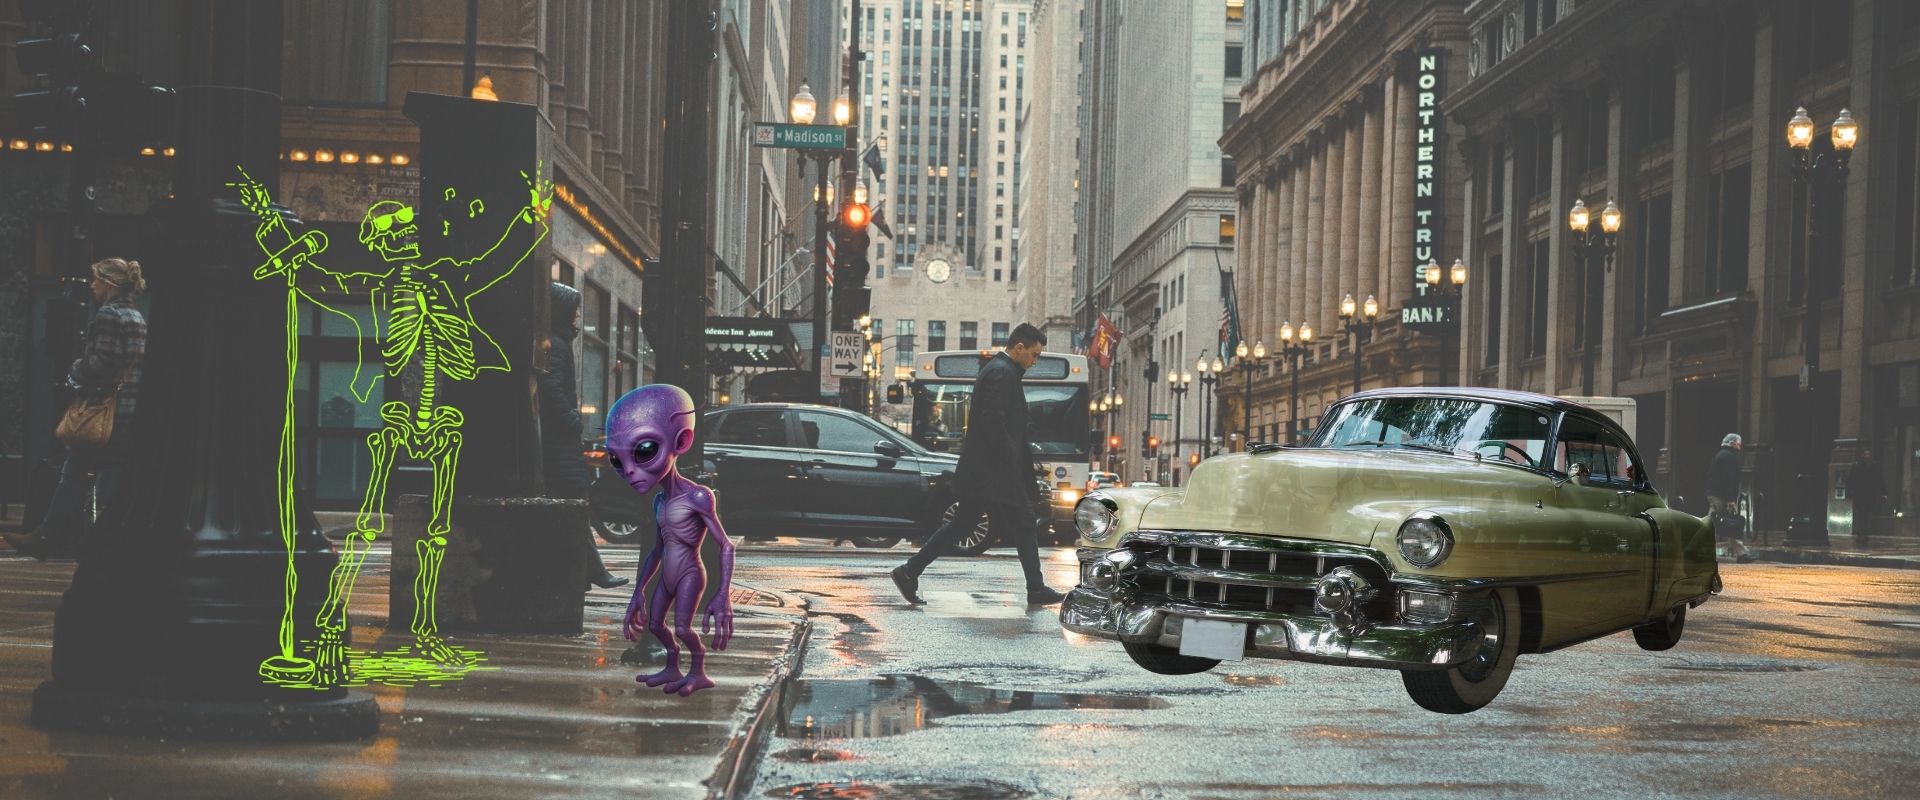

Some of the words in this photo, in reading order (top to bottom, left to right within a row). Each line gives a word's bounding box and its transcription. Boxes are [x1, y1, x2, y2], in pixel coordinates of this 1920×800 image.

[1417, 55, 1436, 197] NORTHERN
[784, 129, 833, 144] Madison
[1416, 210, 1432, 296] TRUST
[730, 328, 744, 336] Inn
[835, 336, 860, 347] ONE
[834, 349, 860, 359] WAY
